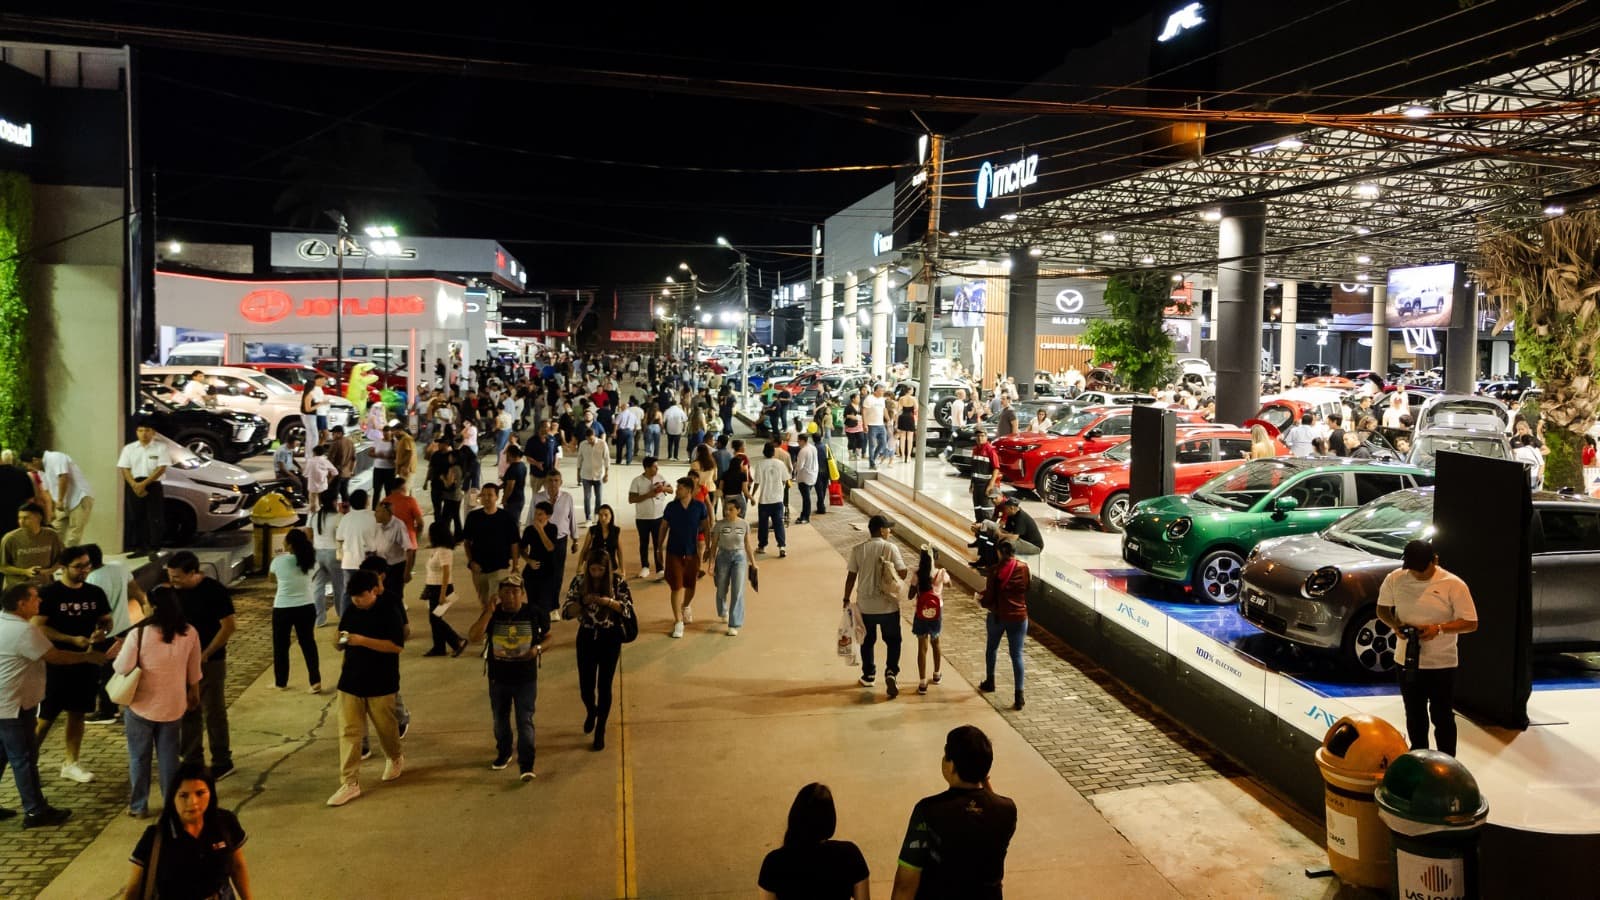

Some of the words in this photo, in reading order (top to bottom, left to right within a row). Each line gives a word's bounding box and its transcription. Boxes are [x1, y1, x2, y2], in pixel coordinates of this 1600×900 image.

[296, 295, 424, 318] JOYLONG
[1052, 317, 1087, 325] MAZDA
[1195, 646, 1214, 664] 100%
